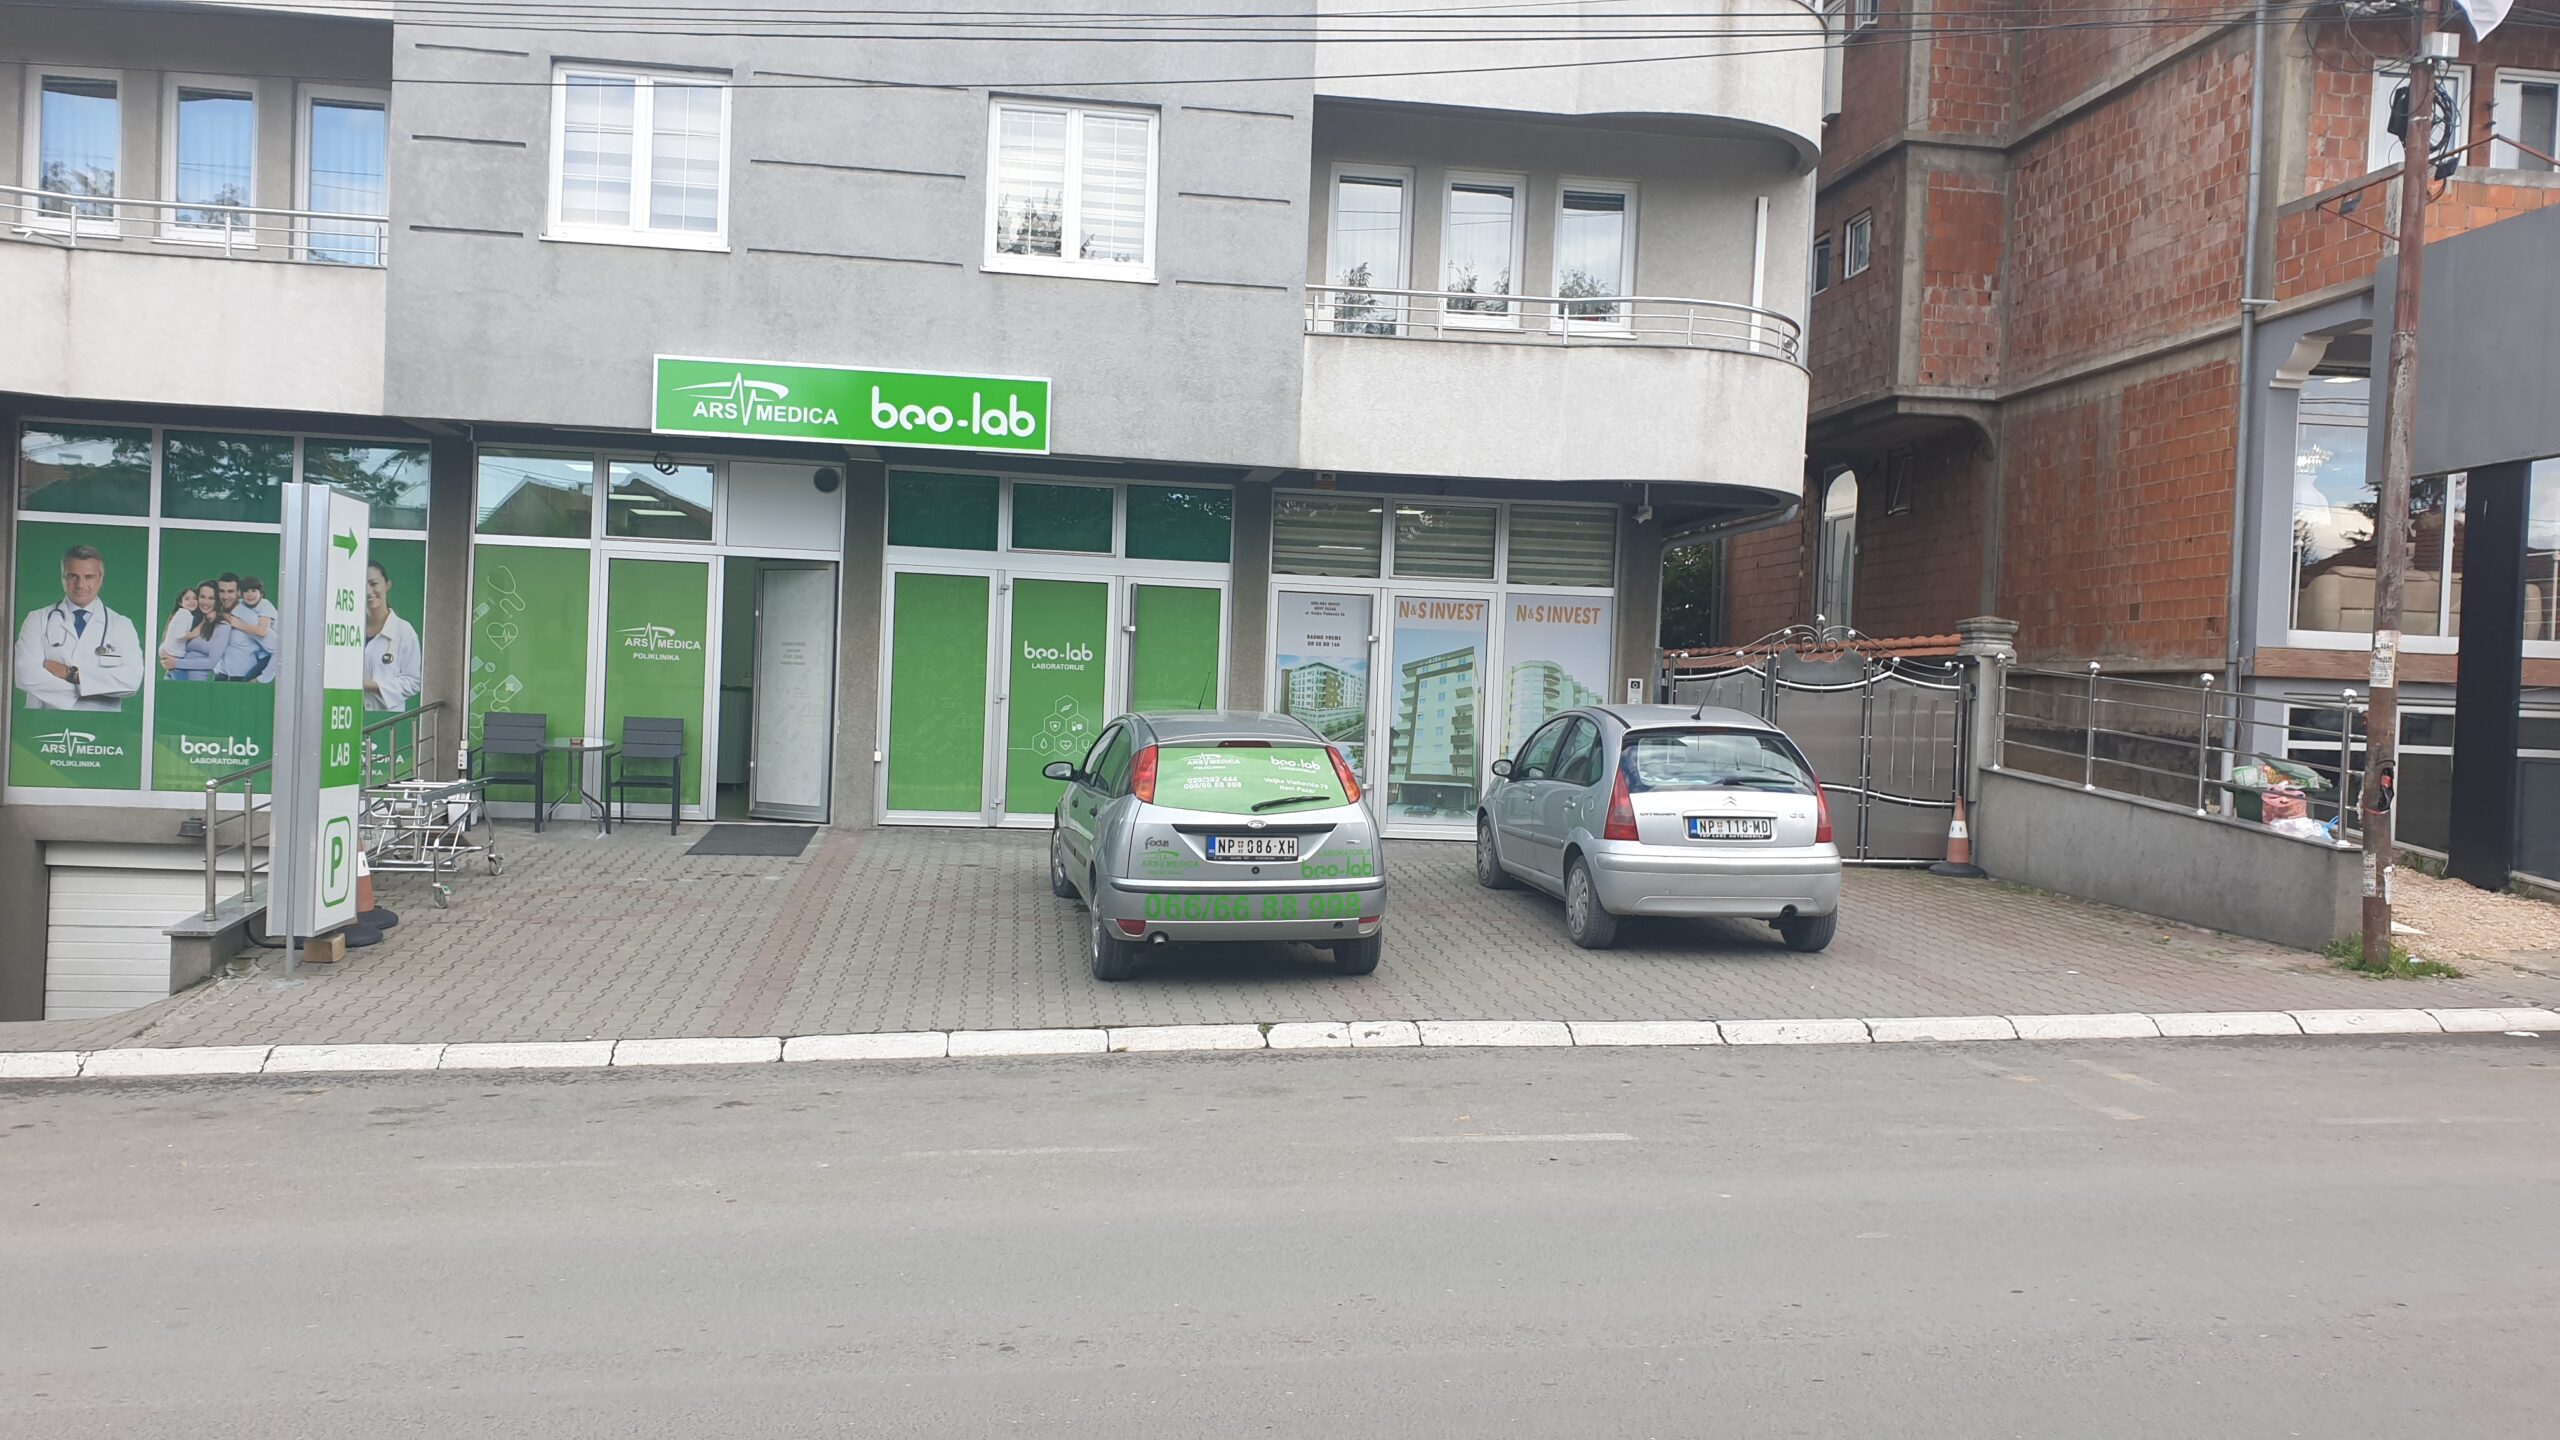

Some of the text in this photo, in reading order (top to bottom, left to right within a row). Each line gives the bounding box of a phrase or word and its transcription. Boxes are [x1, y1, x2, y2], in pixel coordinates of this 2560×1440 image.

[692, 402, 839, 425] ARS MEDICA
[871, 385, 1035, 437] beo-lab
[335, 588, 355, 612] ARS
[1399, 601, 1484, 621] N&S INVEST
[1516, 604, 1601, 625] N&S INVEST
[327, 623, 362, 647] MEDICA
[624, 637, 701, 650] ARS MEDICA
[633, 652, 680, 662] POLIKLINIKA
[1024, 640, 1093, 661] beo-lab
[1031, 663, 1085, 671] LABORATORIJE
[331, 706, 351, 730] BEO
[40, 743, 124, 756] ARS MEDICA
[180, 734, 259, 757] beo-lab
[330, 743, 350, 767] LAB
[50, 759, 101, 768] POLIKLINIKA
[190, 757, 250, 766] LABORATORIJE
[1699, 820, 1715, 833] NP
[1218, 839, 1235, 854] NP
[330, 836, 343, 888] P
[1302, 856, 1373, 878] beo-lab
[1144, 893, 1361, 920] 066/66 88 998
